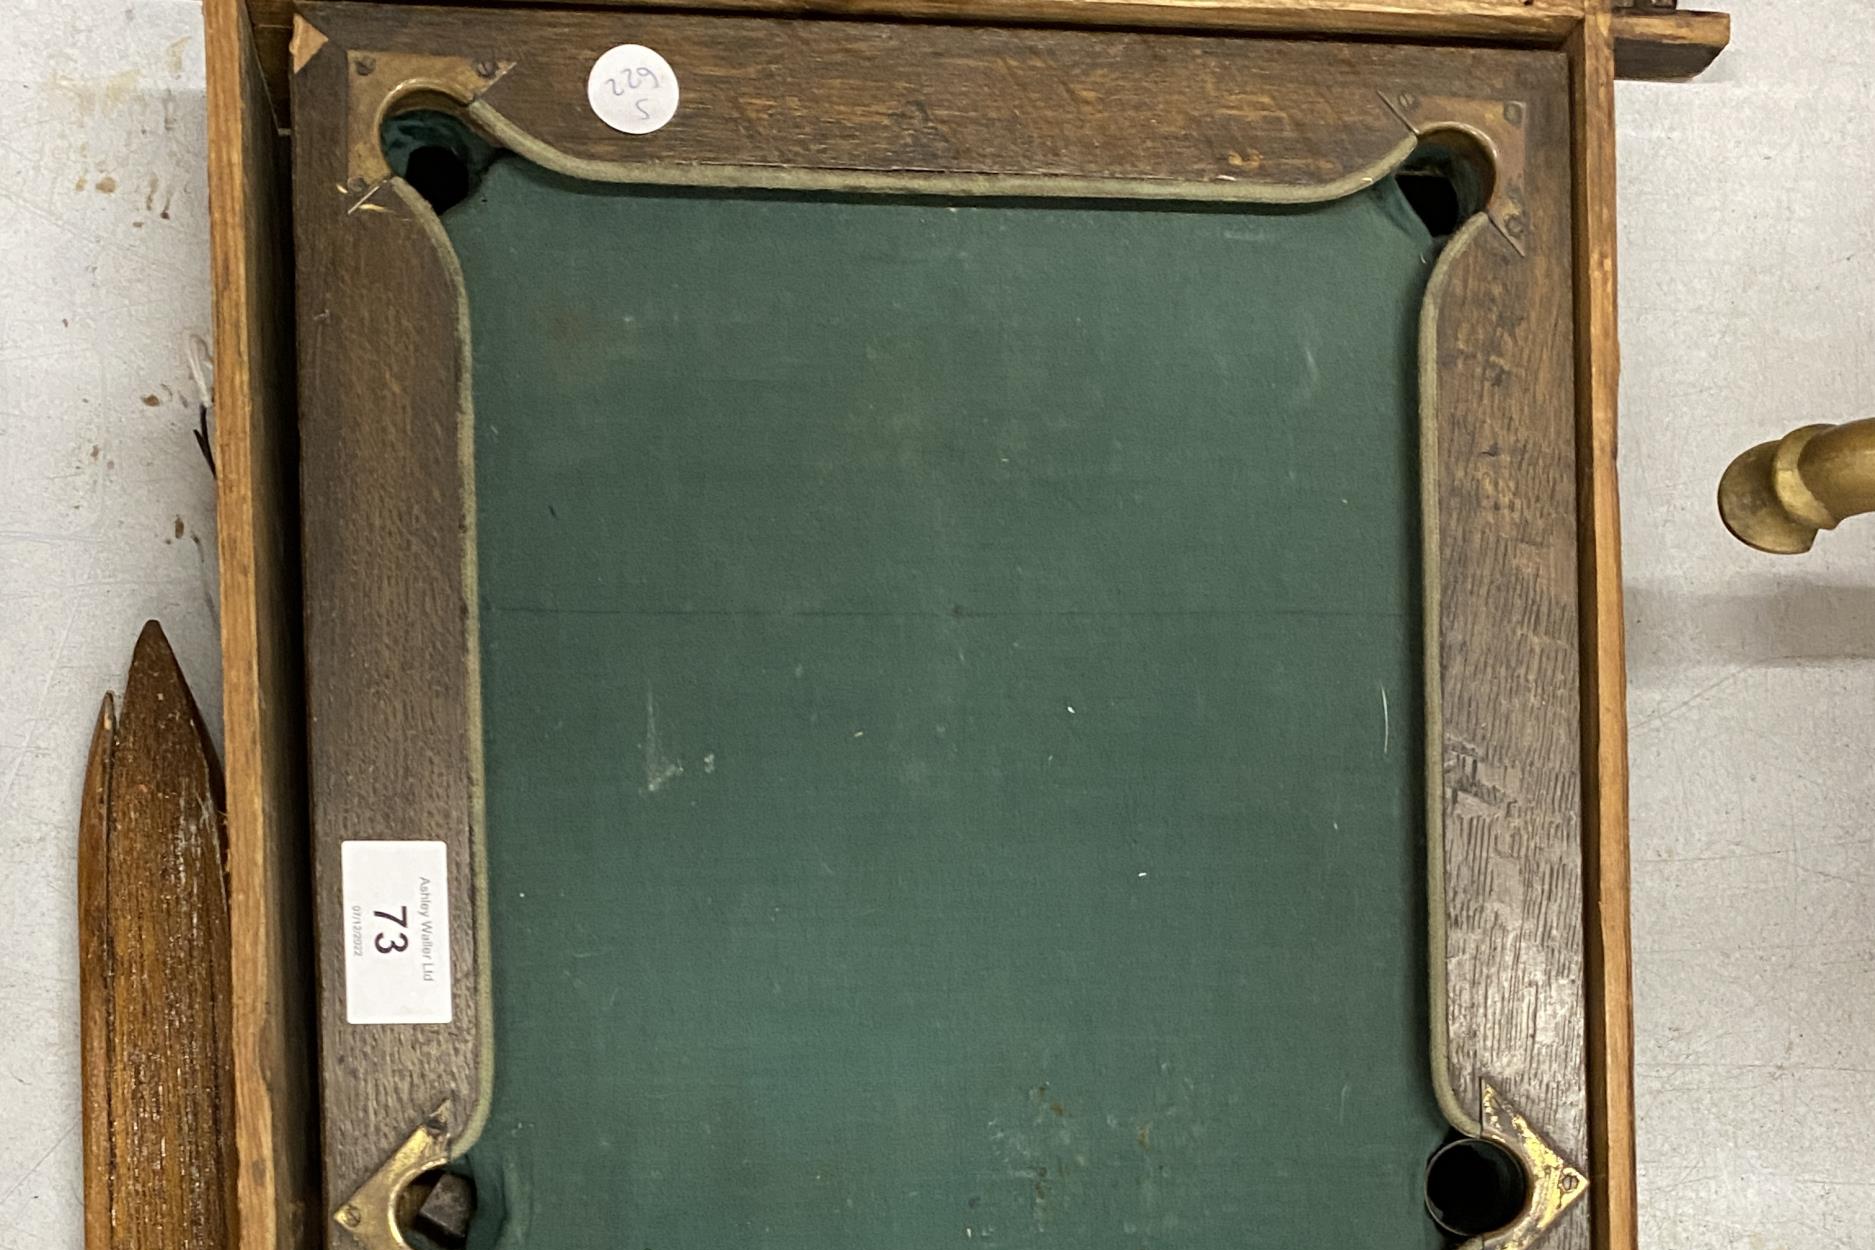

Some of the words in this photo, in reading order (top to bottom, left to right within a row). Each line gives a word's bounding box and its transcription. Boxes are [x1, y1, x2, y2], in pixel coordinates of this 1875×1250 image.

[418, 877, 431, 918] Ashley
[352, 905, 362, 957] 07/12/2022
[373, 905, 408, 954] 73
[421, 921, 433, 960] Waller
[422, 963, 434, 981] Ltd
